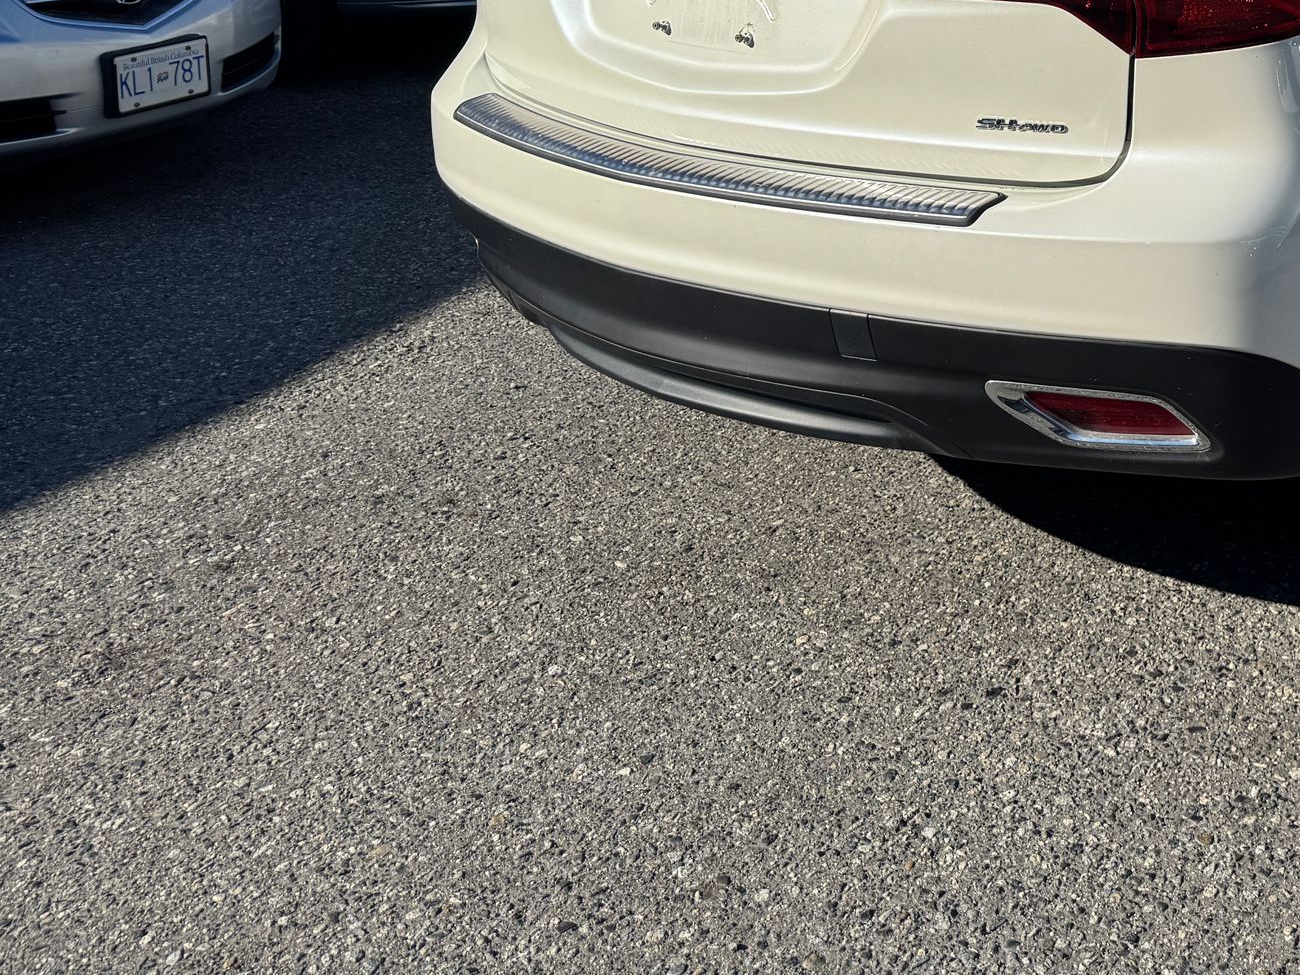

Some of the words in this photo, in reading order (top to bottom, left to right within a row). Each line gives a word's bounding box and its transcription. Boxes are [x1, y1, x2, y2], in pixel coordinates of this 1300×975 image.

[123, 57, 150, 71] Beautiful
[150, 53, 170, 65] British
[170, 48, 199, 60] Columbia
[119, 66, 154, 99] KL1
[168, 55, 204, 86] 78T
